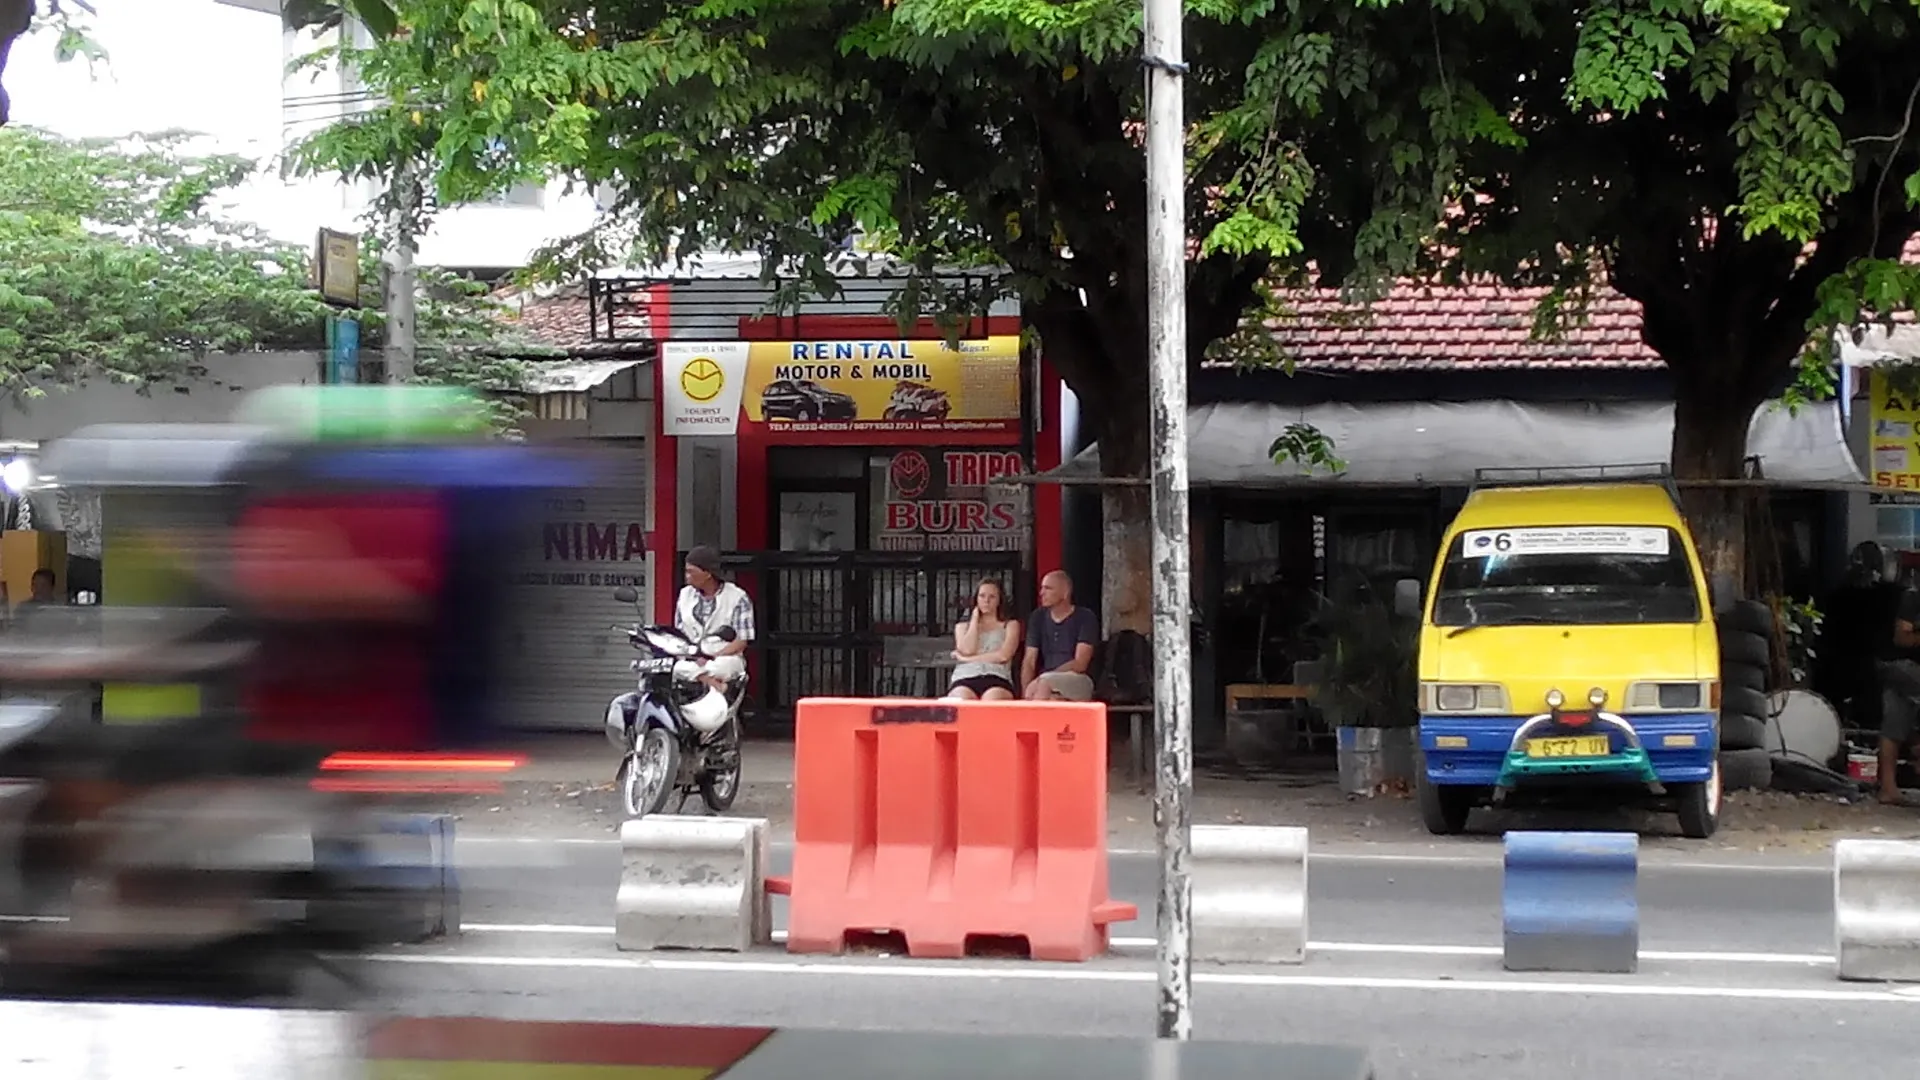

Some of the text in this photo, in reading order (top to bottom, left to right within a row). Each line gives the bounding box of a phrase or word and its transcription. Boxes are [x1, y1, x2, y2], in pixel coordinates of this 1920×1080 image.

[792, 343, 915, 360] RENTAL
[775, 364, 931, 380] MOTOR & MOBIL
[882, 501, 1018, 533] BURS
[1494, 532, 1513, 552] 6
